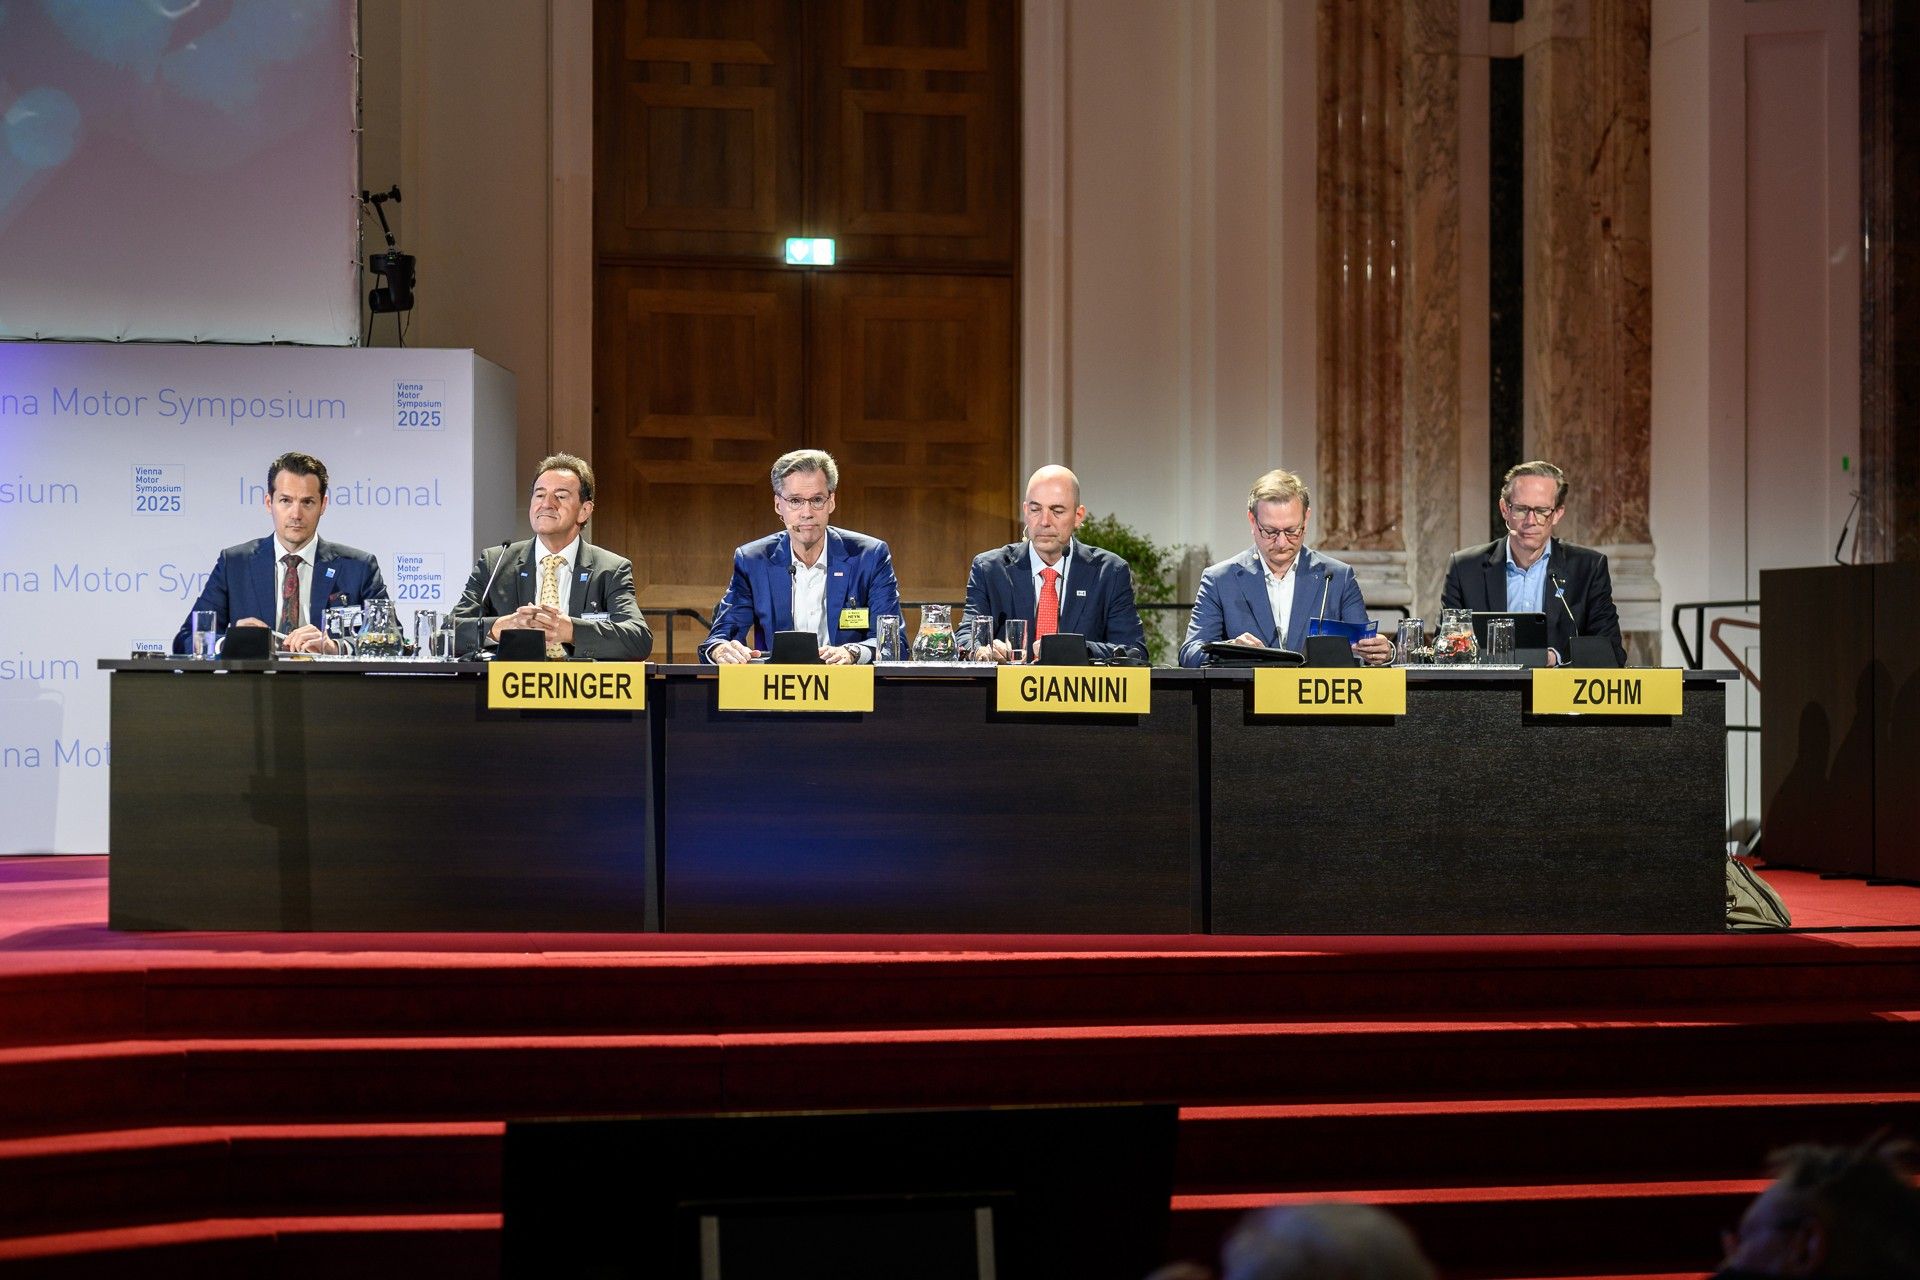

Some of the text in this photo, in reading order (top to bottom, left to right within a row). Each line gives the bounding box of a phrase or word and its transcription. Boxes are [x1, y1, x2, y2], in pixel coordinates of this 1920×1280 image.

[397, 383, 423, 391] Vienna
[397, 391, 420, 399] Motor
[53, 387, 148, 417] Motor
[158, 388, 346, 426] Symposium
[397, 399, 442, 408] Symposium
[398, 411, 441, 427] 2025
[135, 467, 163, 475] Vienna
[135, 476, 160, 484] Motor
[135, 484, 182, 494] Symposium
[240, 477, 442, 506] Inational
[136, 495, 181, 512] 2025
[397, 556, 423, 564] Vienna
[54, 564, 149, 592] Motor
[397, 573, 442, 582] Symposium
[398, 584, 441, 599] 2025
[136, 642, 163, 650] Vienna
[502, 672, 632, 699] GERINGER
[764, 675, 829, 700] HEYN
[1020, 676, 1127, 703] GIANNINI
[1299, 679, 1363, 704] EDER
[1573, 679, 1642, 705] ZOHM
